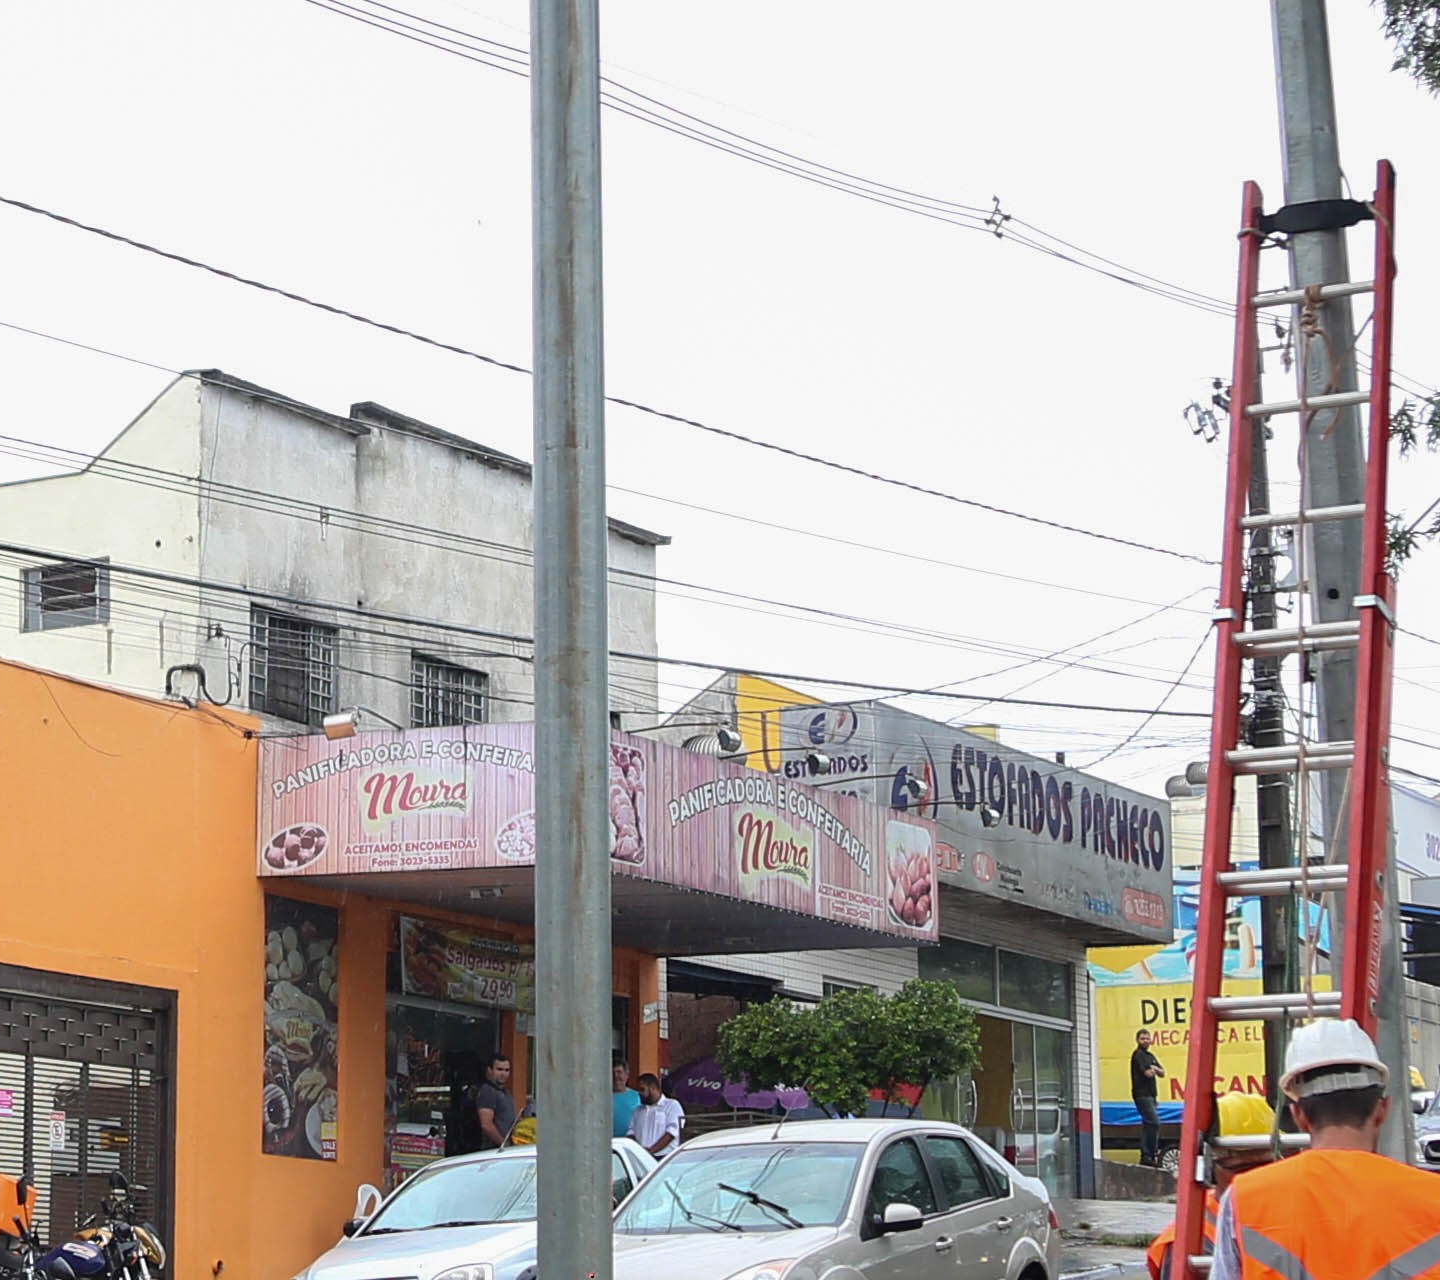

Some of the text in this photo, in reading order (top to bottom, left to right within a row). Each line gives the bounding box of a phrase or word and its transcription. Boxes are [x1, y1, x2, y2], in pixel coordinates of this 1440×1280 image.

[271, 740, 537, 800] PANIFICADORA E CONFEITA
[364, 772, 468, 820] Moura
[668, 776, 872, 878] PANIFICADORA E CONFEITARIA
[950, 742, 1165, 872] ESTOFADOS PACHECO
[345, 839, 478, 855] ACEITAMOS ENCOMENDAS
[738, 811, 810, 874] Moura
[1141, 998, 1195, 1025] DIE
[687, 1077, 722, 1091] vivo
